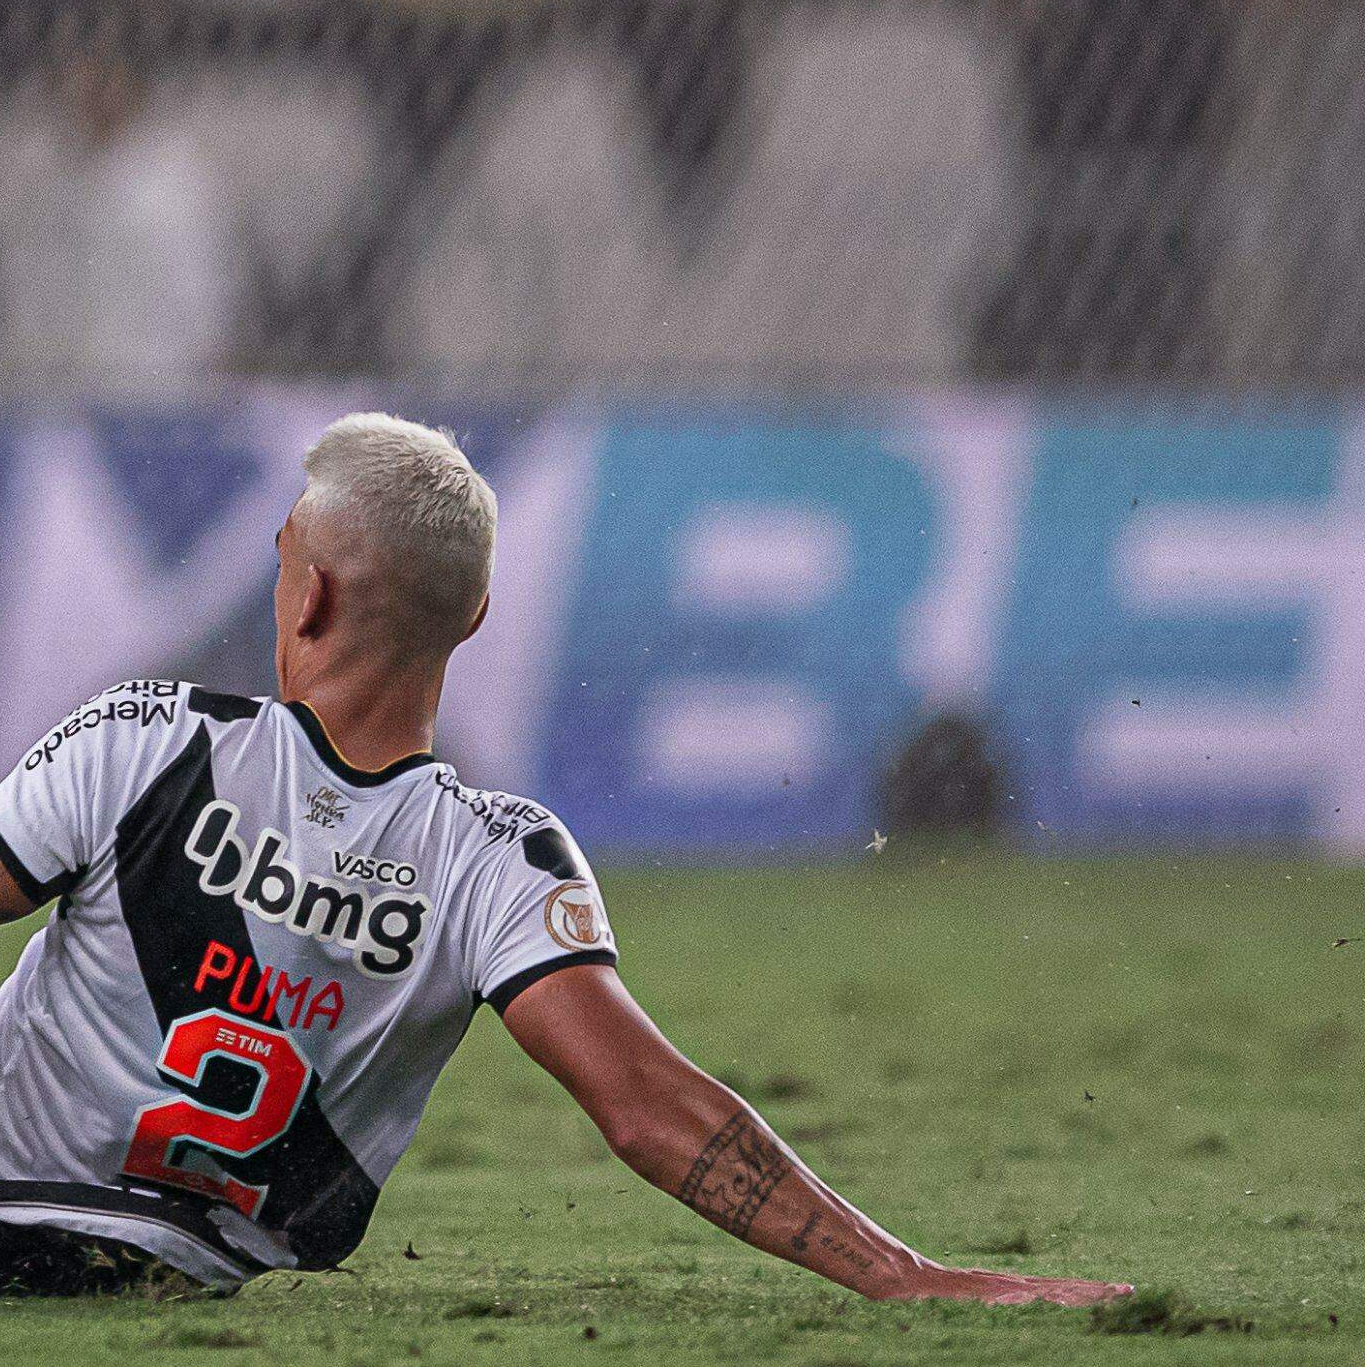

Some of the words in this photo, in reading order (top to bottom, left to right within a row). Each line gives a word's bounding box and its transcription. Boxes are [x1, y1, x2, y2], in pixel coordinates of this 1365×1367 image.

[25, 700, 177, 771] Mercado
[241, 835, 427, 975] bmg
[334, 851, 417, 887] VASCO
[193, 939, 346, 1032] PUMA
[238, 1034, 273, 1058] TIM
[122, 1008, 314, 1221] 2
